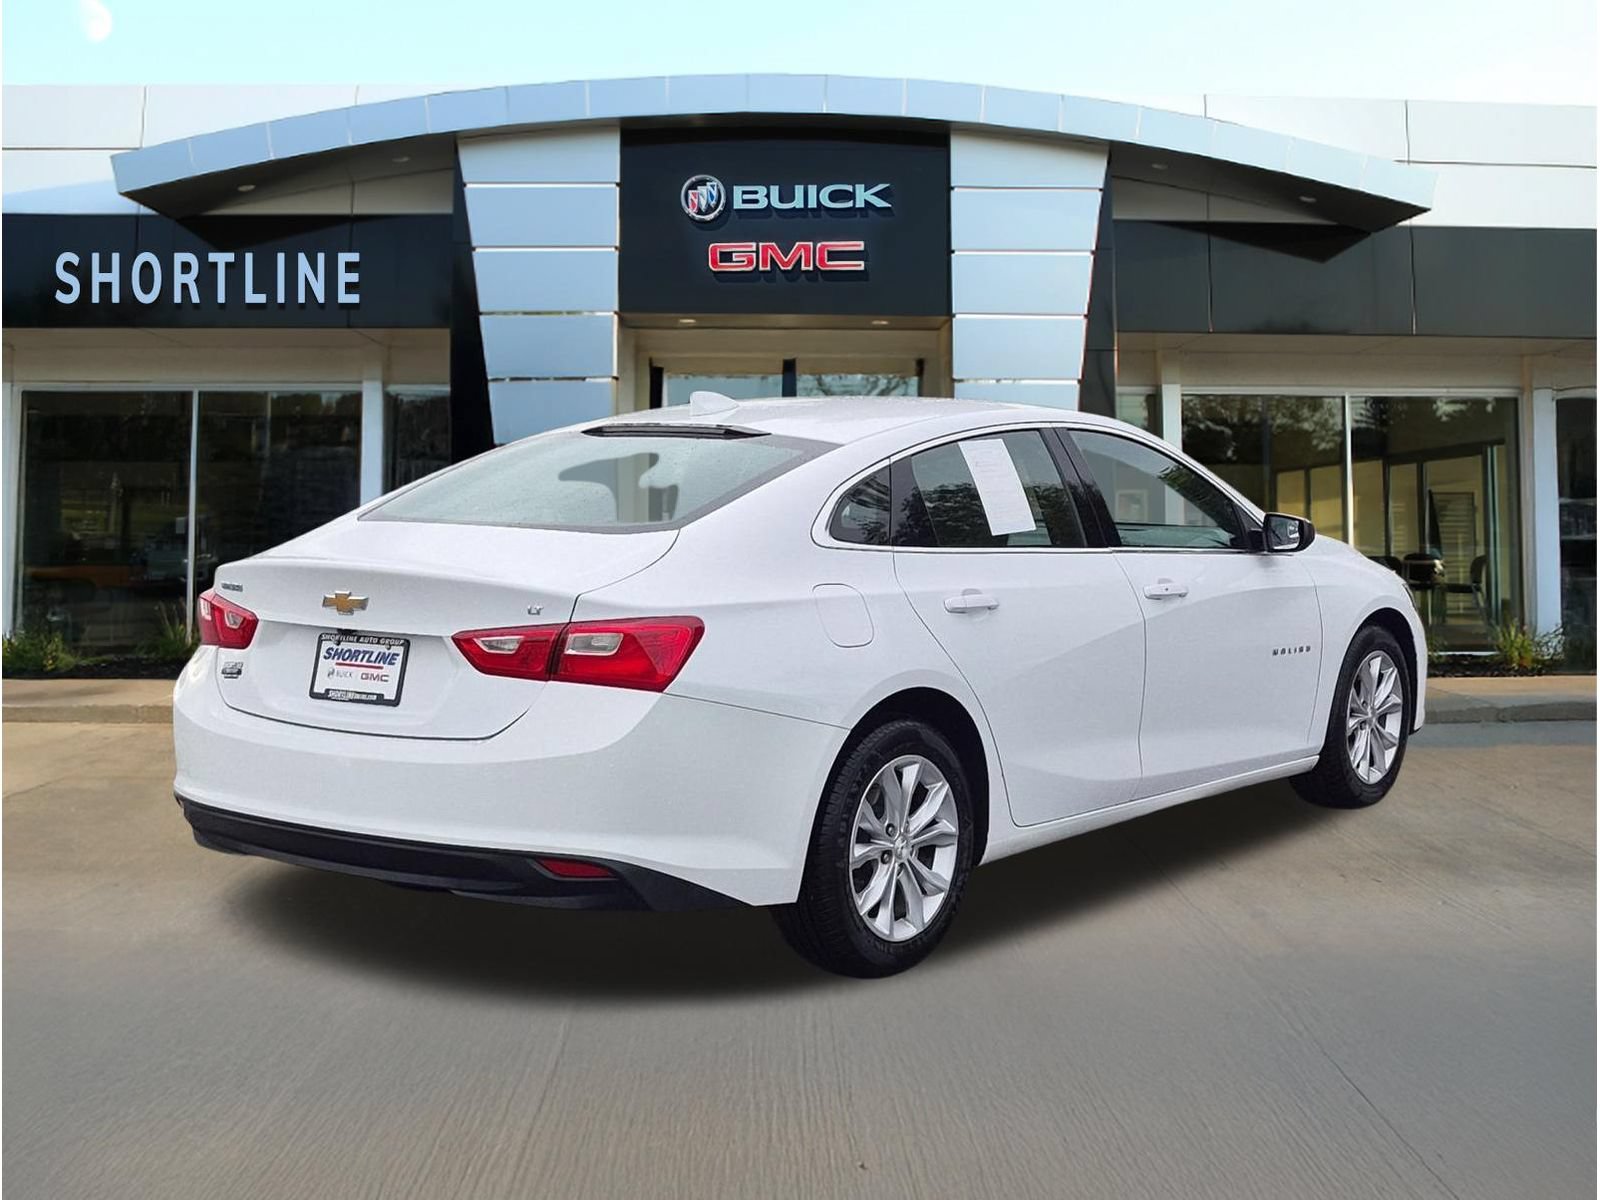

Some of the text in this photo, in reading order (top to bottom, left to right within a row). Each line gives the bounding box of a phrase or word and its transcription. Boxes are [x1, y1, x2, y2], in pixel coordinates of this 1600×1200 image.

[733, 183, 892, 209] BUICK
[709, 241, 864, 271] GMC
[55, 252, 360, 304] SHORTLINE
[527, 604, 544, 616] LT
[323, 647, 400, 665] SHORTLINE
[360, 672, 389, 683] GMC
